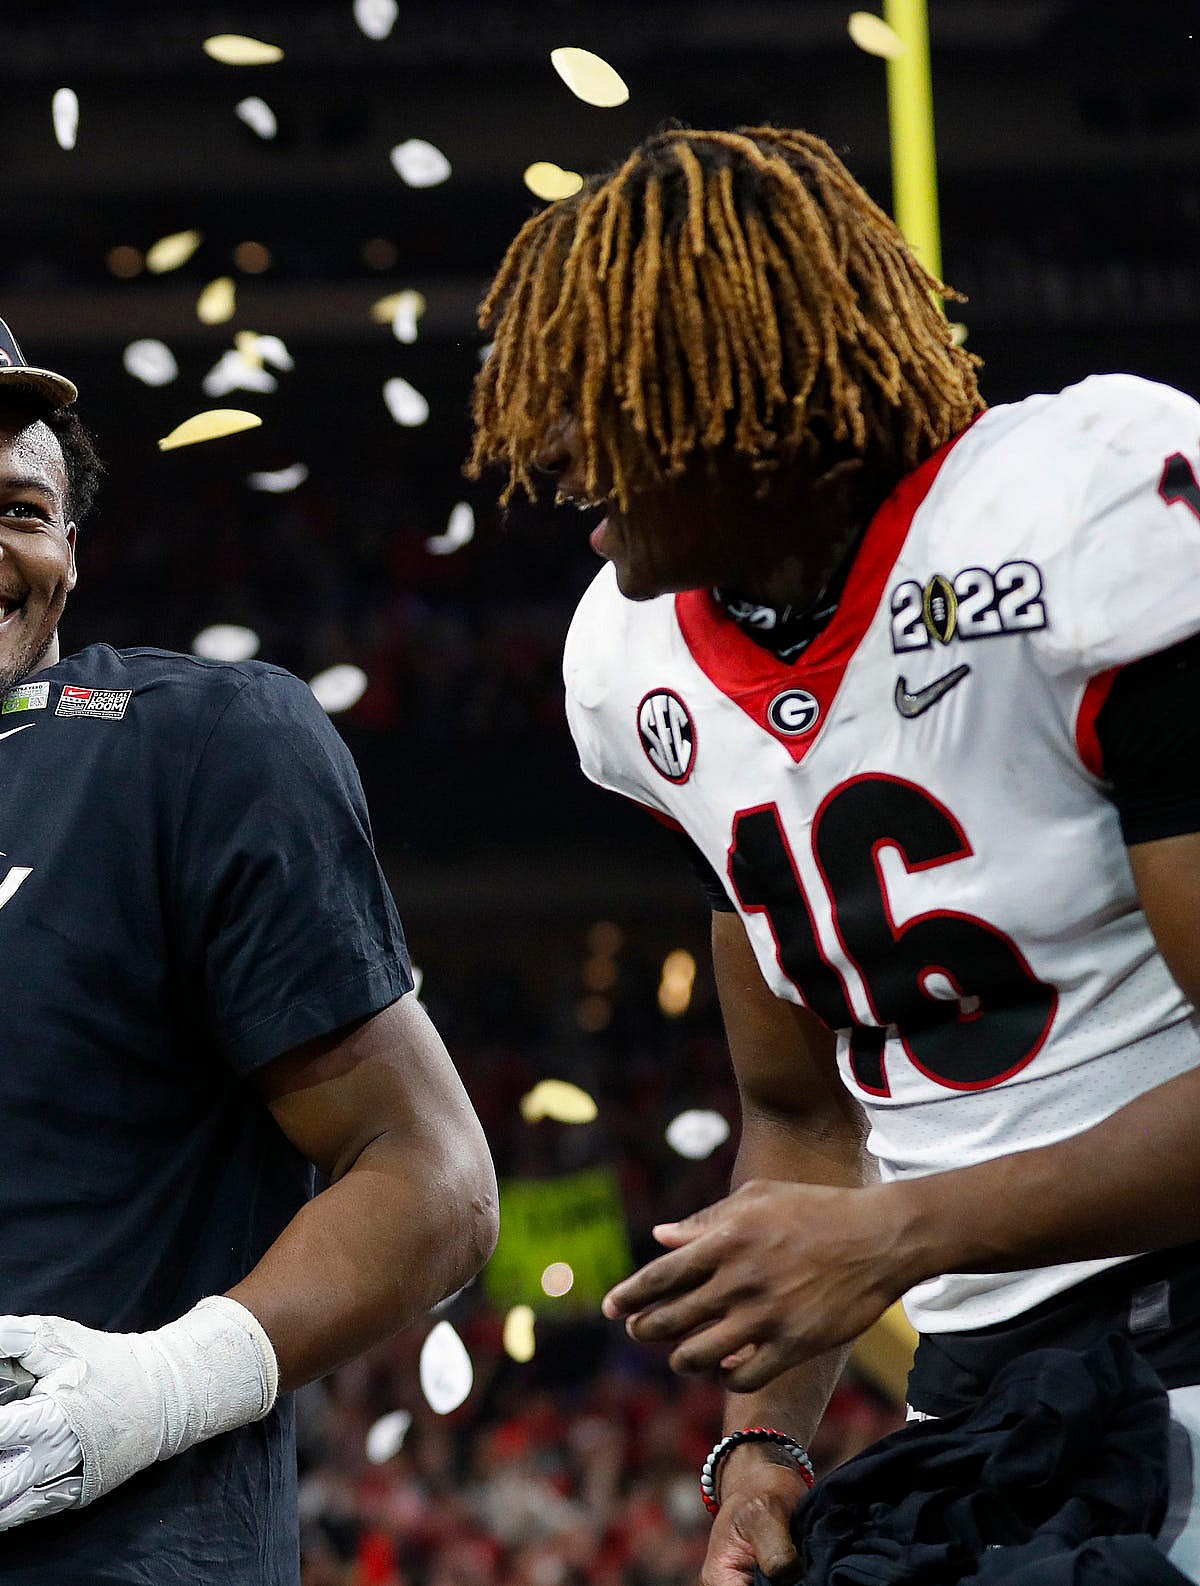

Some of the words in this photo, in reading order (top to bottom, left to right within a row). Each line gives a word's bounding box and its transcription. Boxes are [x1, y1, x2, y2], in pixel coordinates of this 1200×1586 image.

[892, 561, 1048, 654] 2022
[87, 703, 123, 712] ROOM
[640, 692, 695, 778] SEC
[727, 771, 1058, 1097] 16
